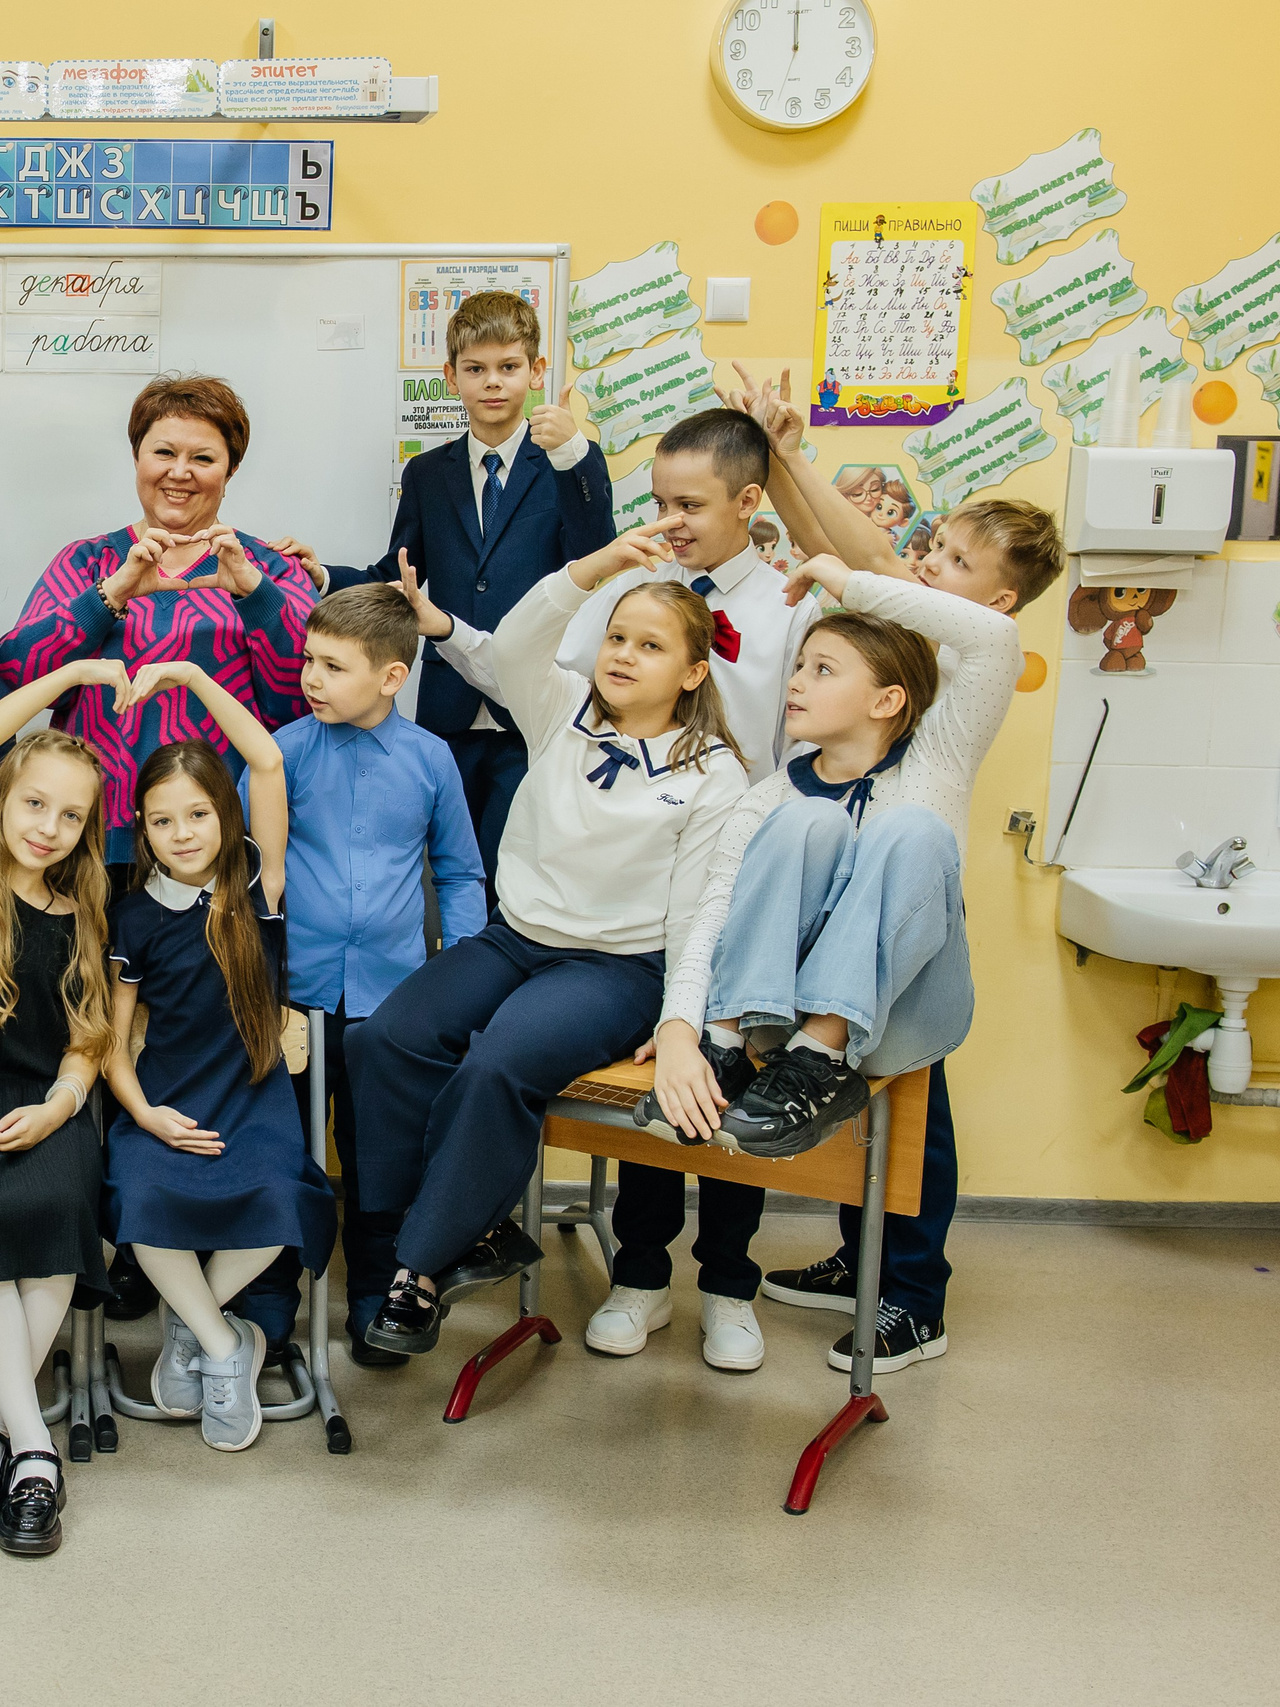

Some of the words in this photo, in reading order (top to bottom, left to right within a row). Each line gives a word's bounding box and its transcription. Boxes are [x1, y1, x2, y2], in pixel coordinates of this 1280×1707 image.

[734, 9, 761, 31] 10
[838, 7, 856, 29] 2
[729, 39, 747, 60] 9
[845, 36, 862, 58] 3
[251, 65, 318, 78] эпитет
[736, 68, 753, 90] 8
[835, 66, 853, 87] 4
[757, 90, 773, 111] 7
[785, 97, 802, 118] 6
[814, 88, 831, 109] 5
[18, 146, 50, 182] Д
[56, 146, 92, 178] Ж
[101, 147, 125, 179] З
[301, 149, 323, 180] Ь
[1040, 172, 1074, 194] книга
[23, 188, 47, 219] Т
[57, 188, 91, 219] Ш
[100, 188, 124, 220] С
[137, 189, 165, 220] Х
[177, 189, 206, 224] Ц
[218, 190, 241, 221] Ч
[251, 190, 287, 225] Щ
[295, 191, 321, 222] Ъ
[833, 220, 870, 232] ПИШИ
[888, 219, 962, 231] ПРАВИЛЬНО
[436, 266, 461, 274] КЛАССЫ
[19, 260, 144, 308] декабря
[629, 273, 673, 297] соседа
[409, 290, 439, 310] 835
[1015, 294, 1054, 318] Книга
[1194, 290, 1232, 317] Книга
[26, 319, 153, 365] работа
[412, 406, 425, 414] ЭТО
[919, 433, 963, 460] Золото
[964, 399, 1022, 439] добывают
